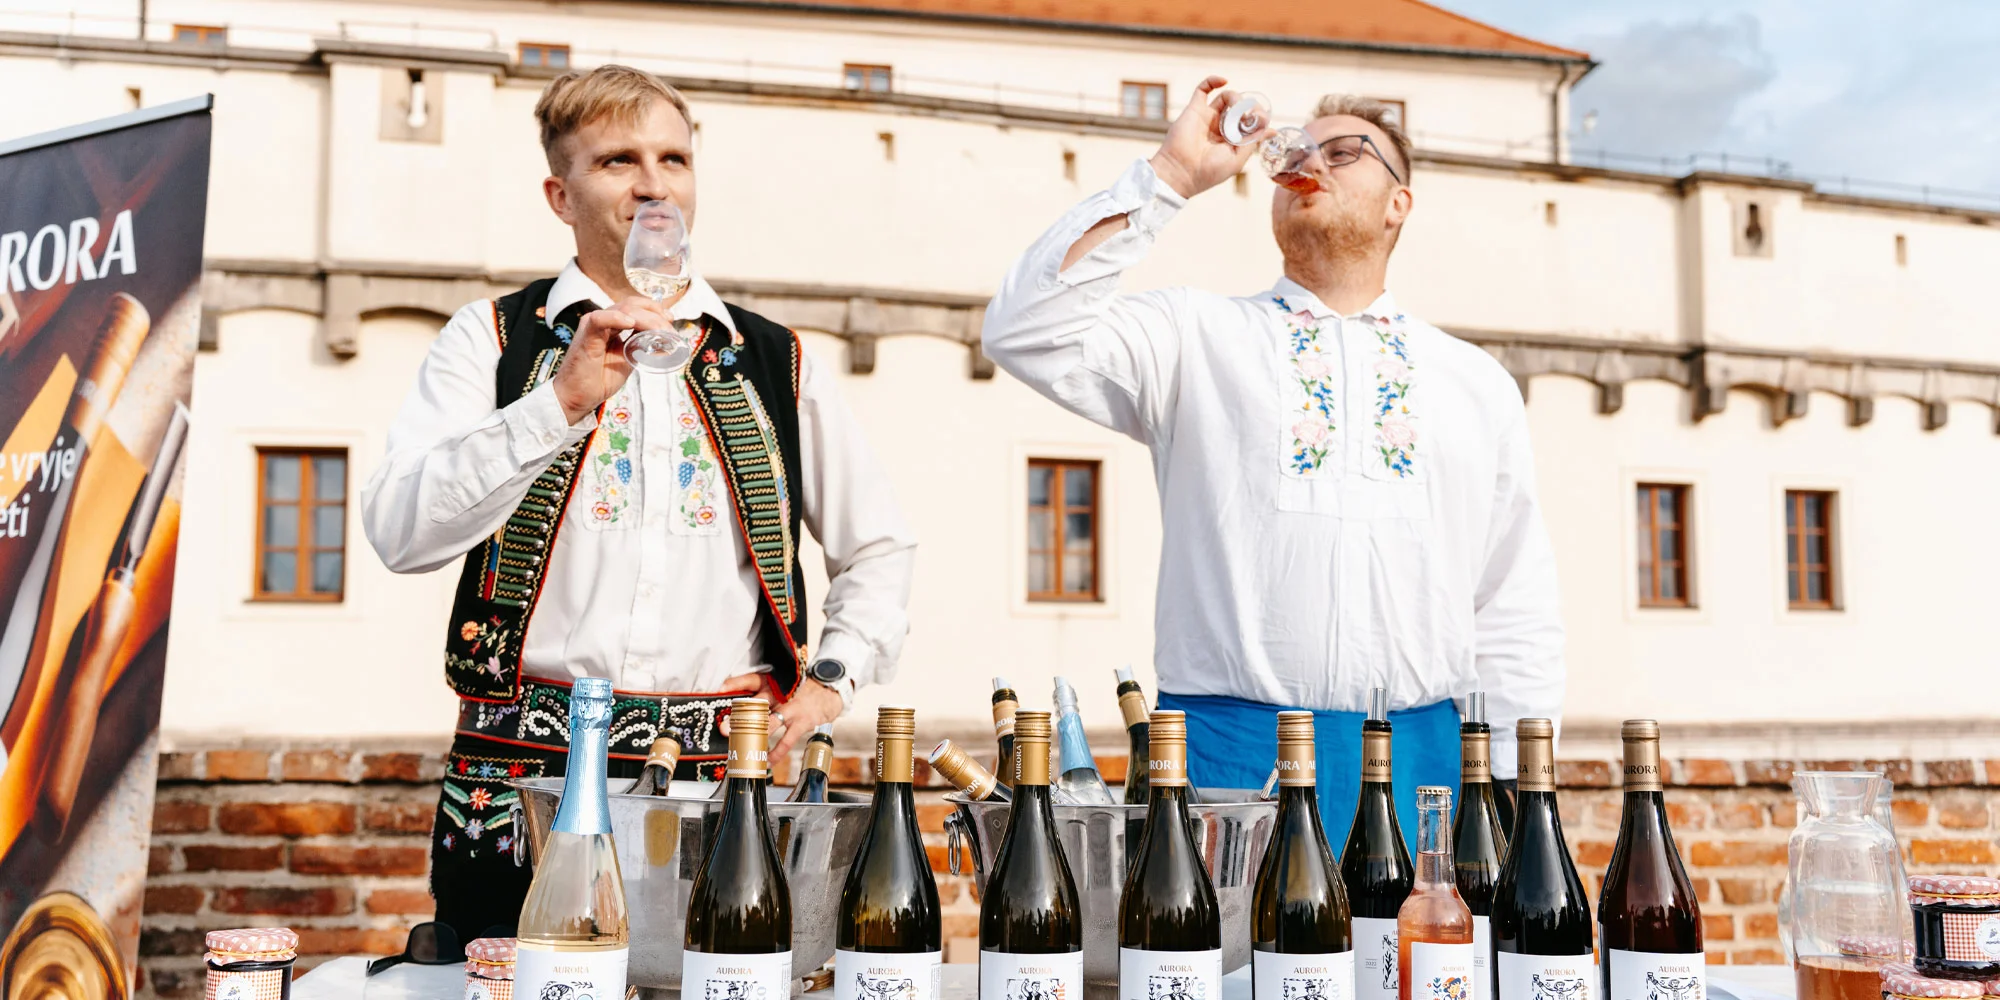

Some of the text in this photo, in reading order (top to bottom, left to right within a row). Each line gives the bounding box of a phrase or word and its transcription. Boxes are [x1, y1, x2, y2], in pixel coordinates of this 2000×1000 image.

[11, 435, 76, 493] vryje
[715, 966, 752, 975] AURORA
[866, 967, 902, 975] AURORA
[1158, 964, 1193, 973] AURORA
[1293, 966, 1328, 975] AURORA
[1543, 968, 1577, 976] AURORA
[1658, 965, 1691, 973] AURORA
